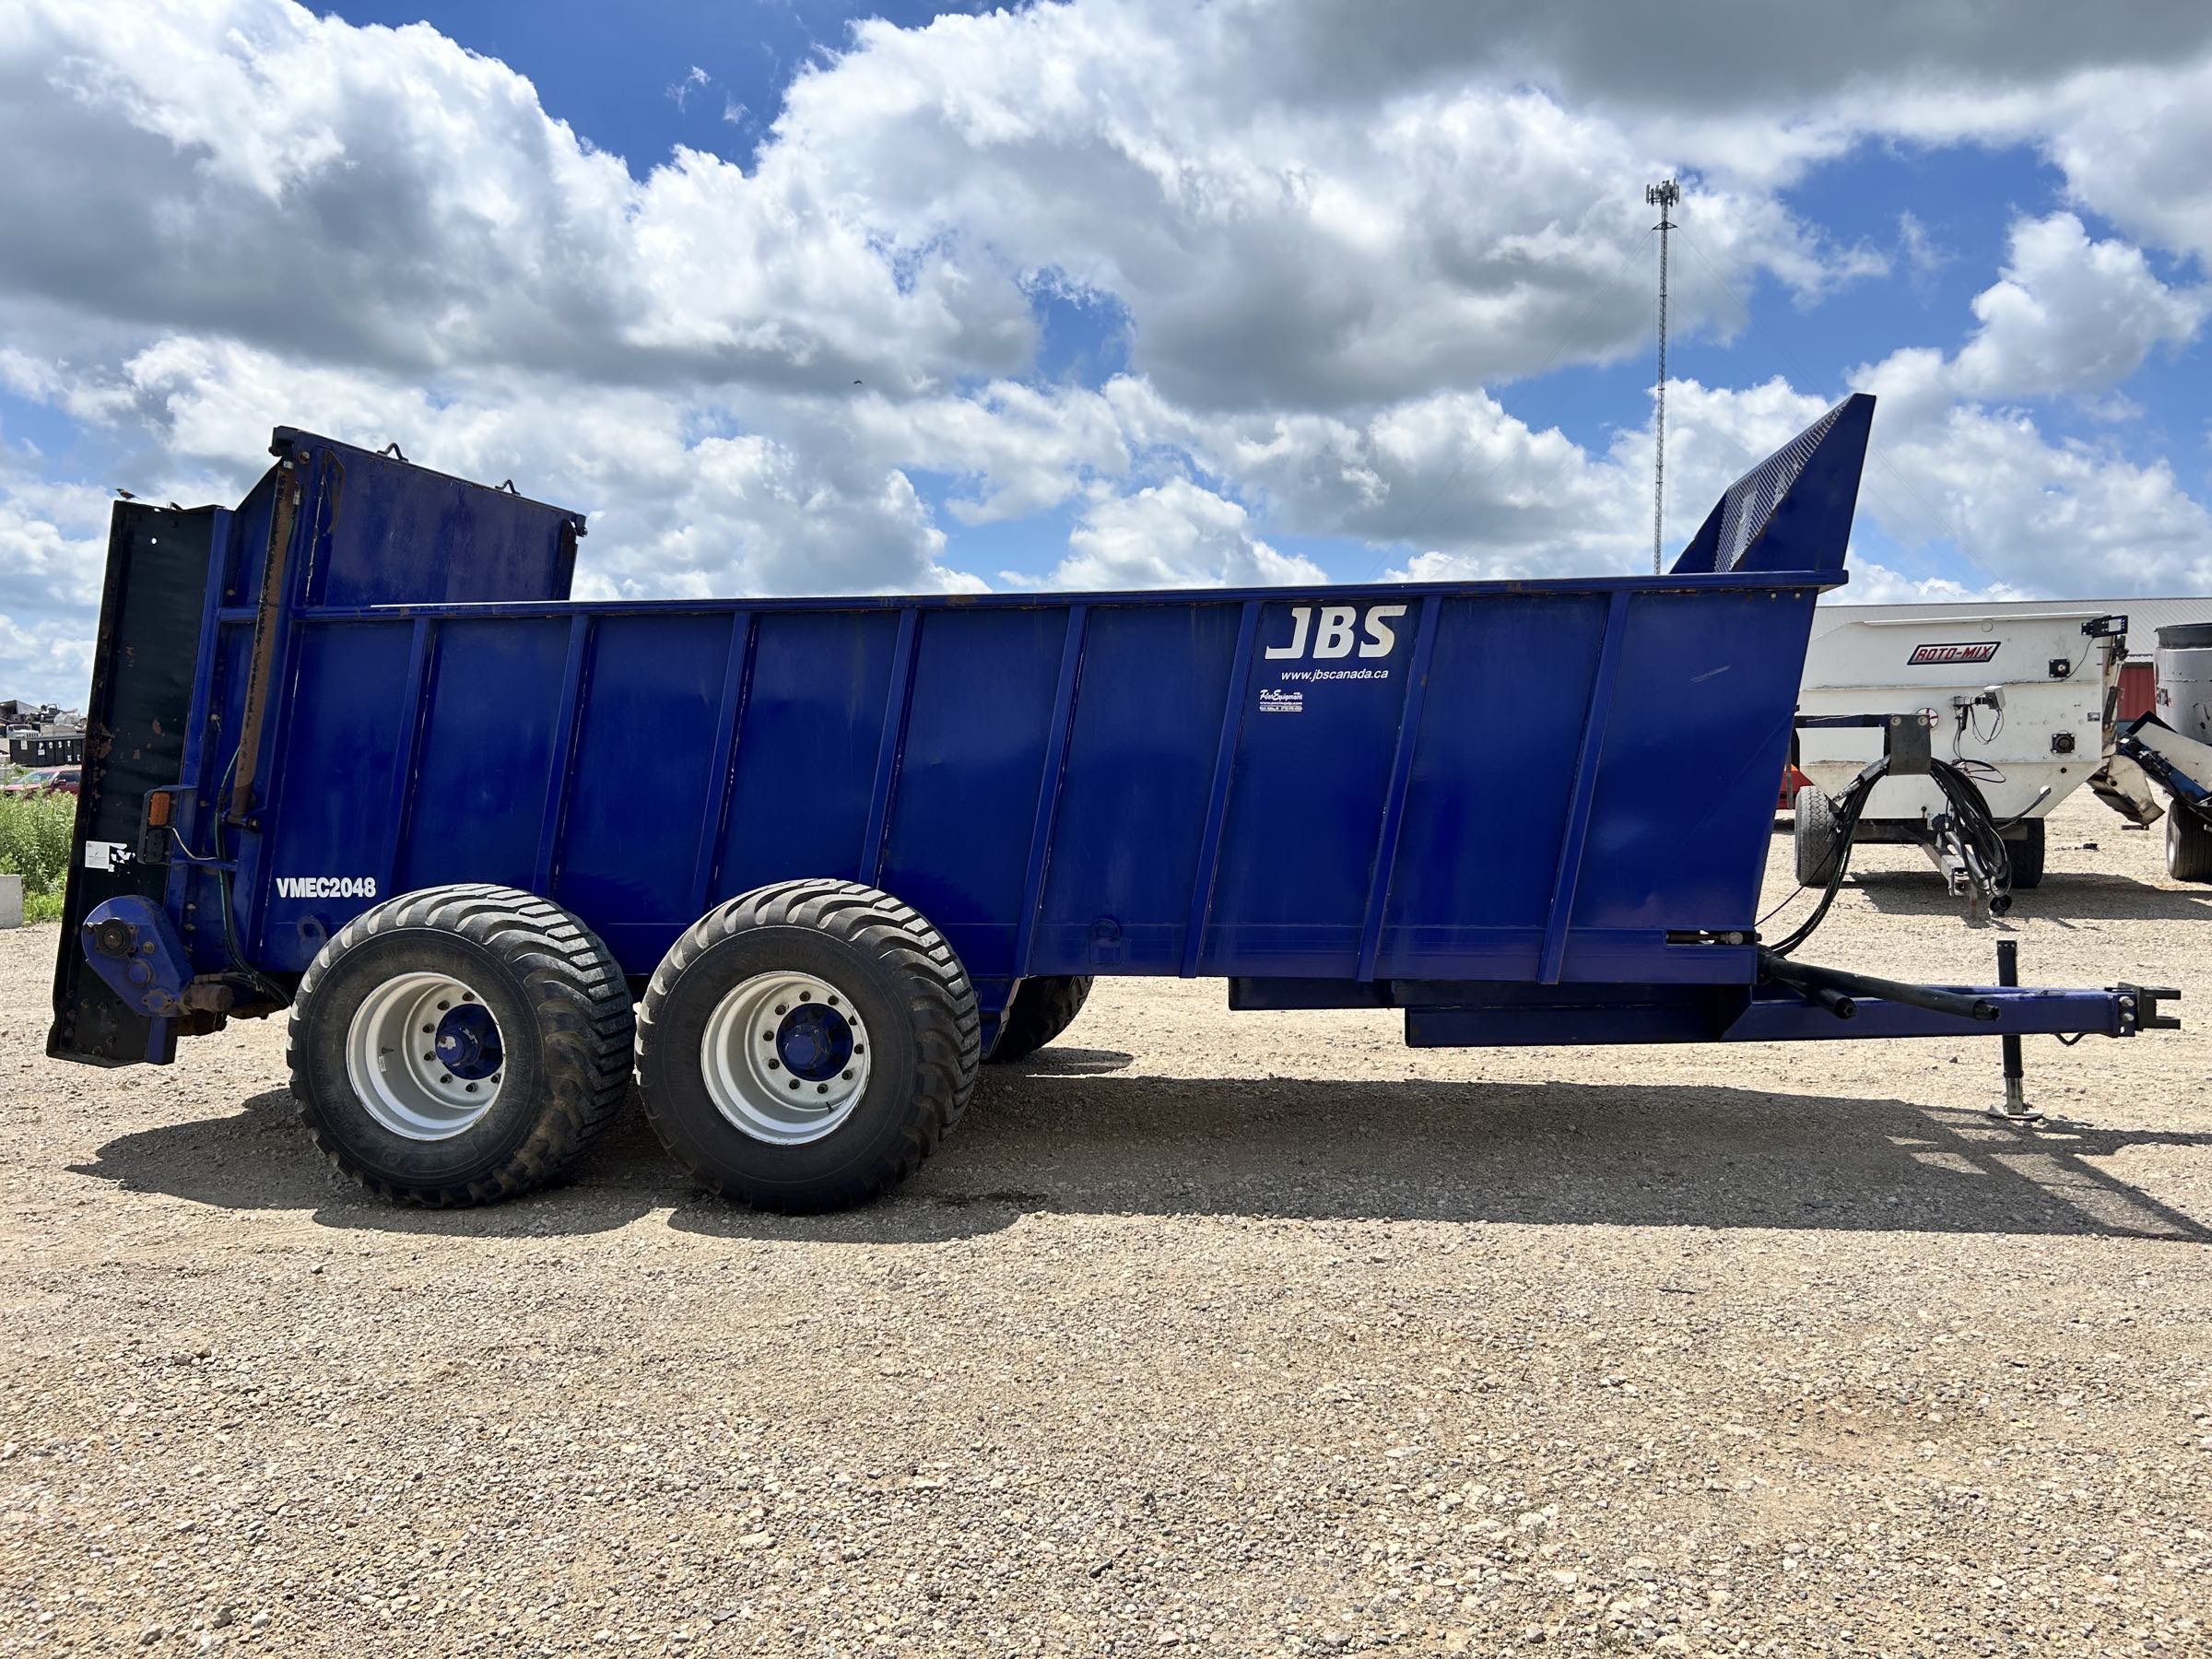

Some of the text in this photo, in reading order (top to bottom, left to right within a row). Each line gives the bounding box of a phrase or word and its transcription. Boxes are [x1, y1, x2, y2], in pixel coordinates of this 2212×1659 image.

[1265, 605, 1407, 660] JBS
[1914, 645, 1994, 661] ROTO-MIX
[1281, 668, 1389, 682] www.jbscanada.ca
[276, 877, 376, 898] VMEC2048
